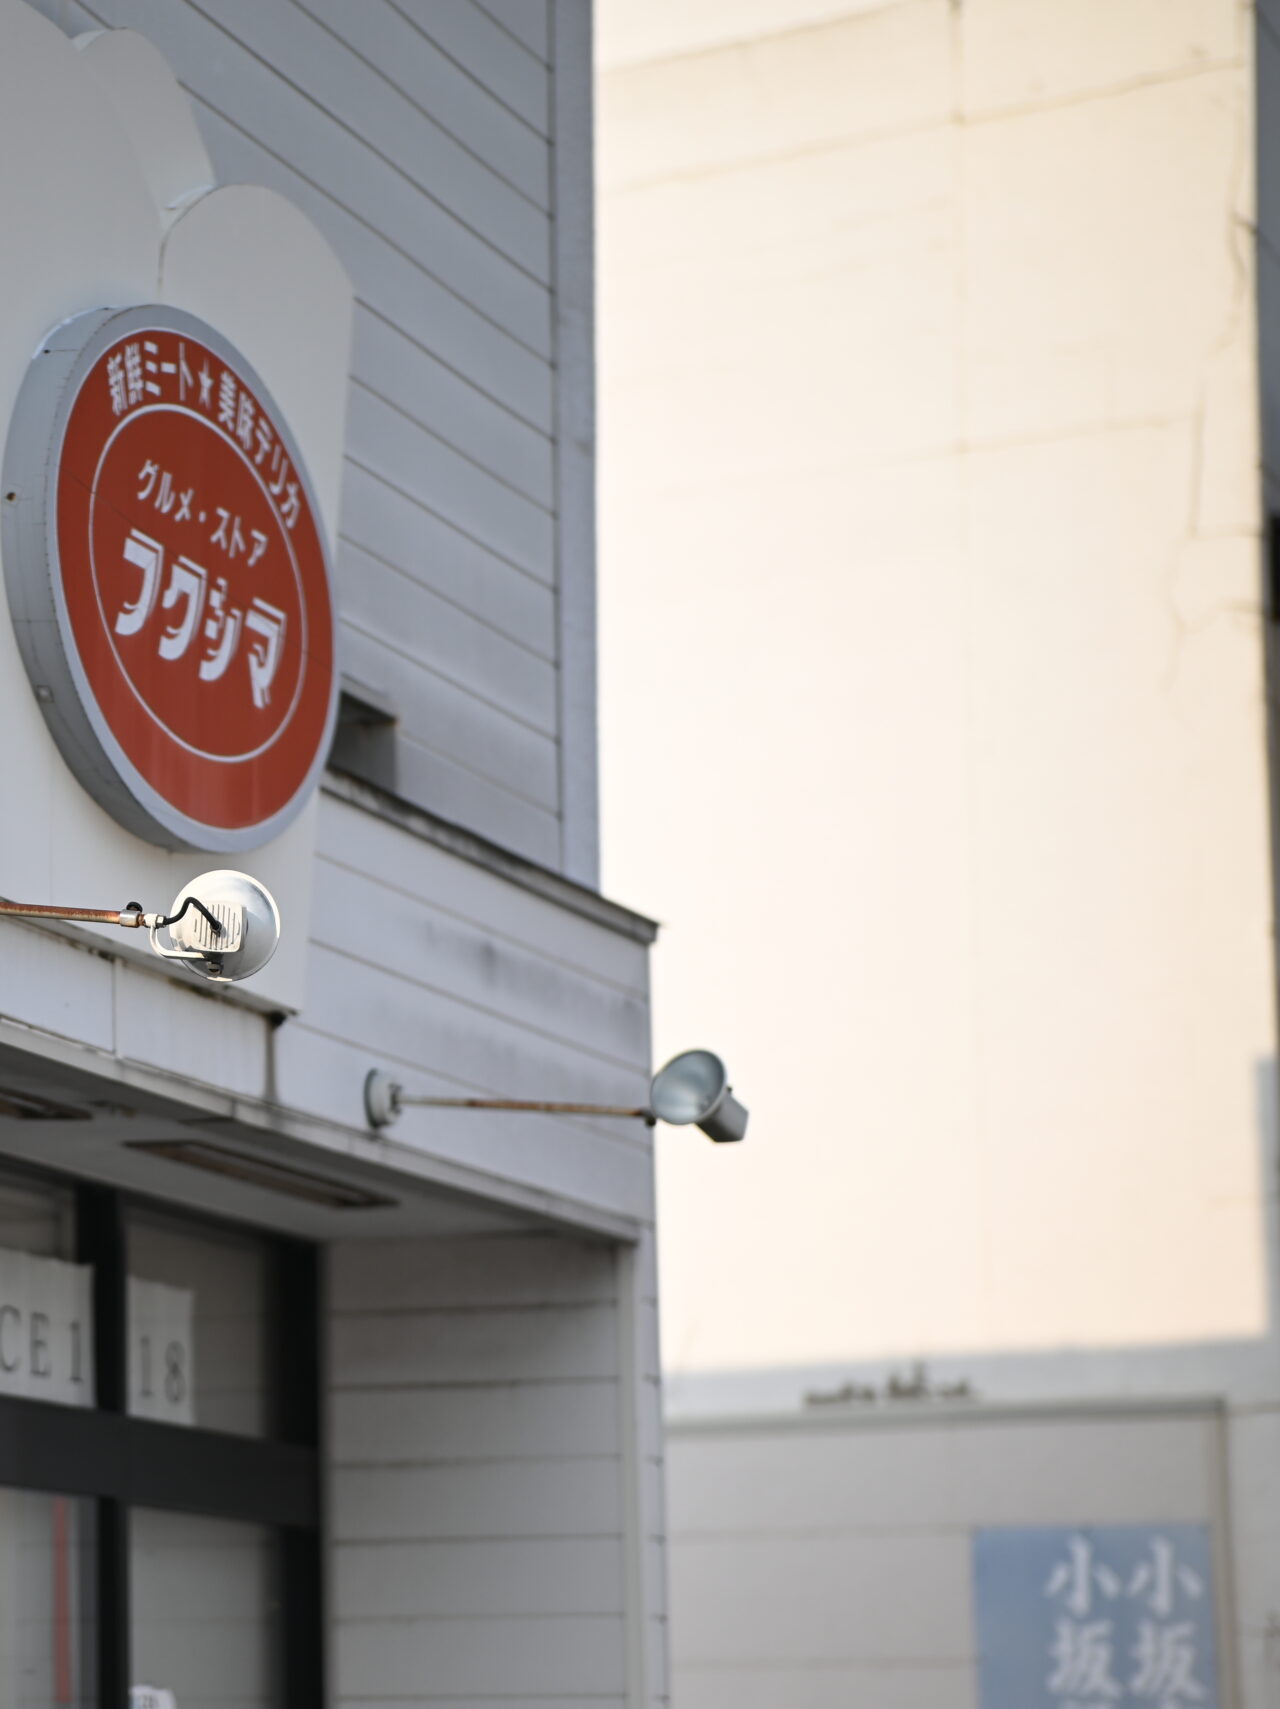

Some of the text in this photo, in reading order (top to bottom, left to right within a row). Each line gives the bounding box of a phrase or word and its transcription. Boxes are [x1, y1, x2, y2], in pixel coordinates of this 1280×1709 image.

[137, 459, 269, 568] グルメ・ストア
[114, 527, 288, 710] フクシマ
